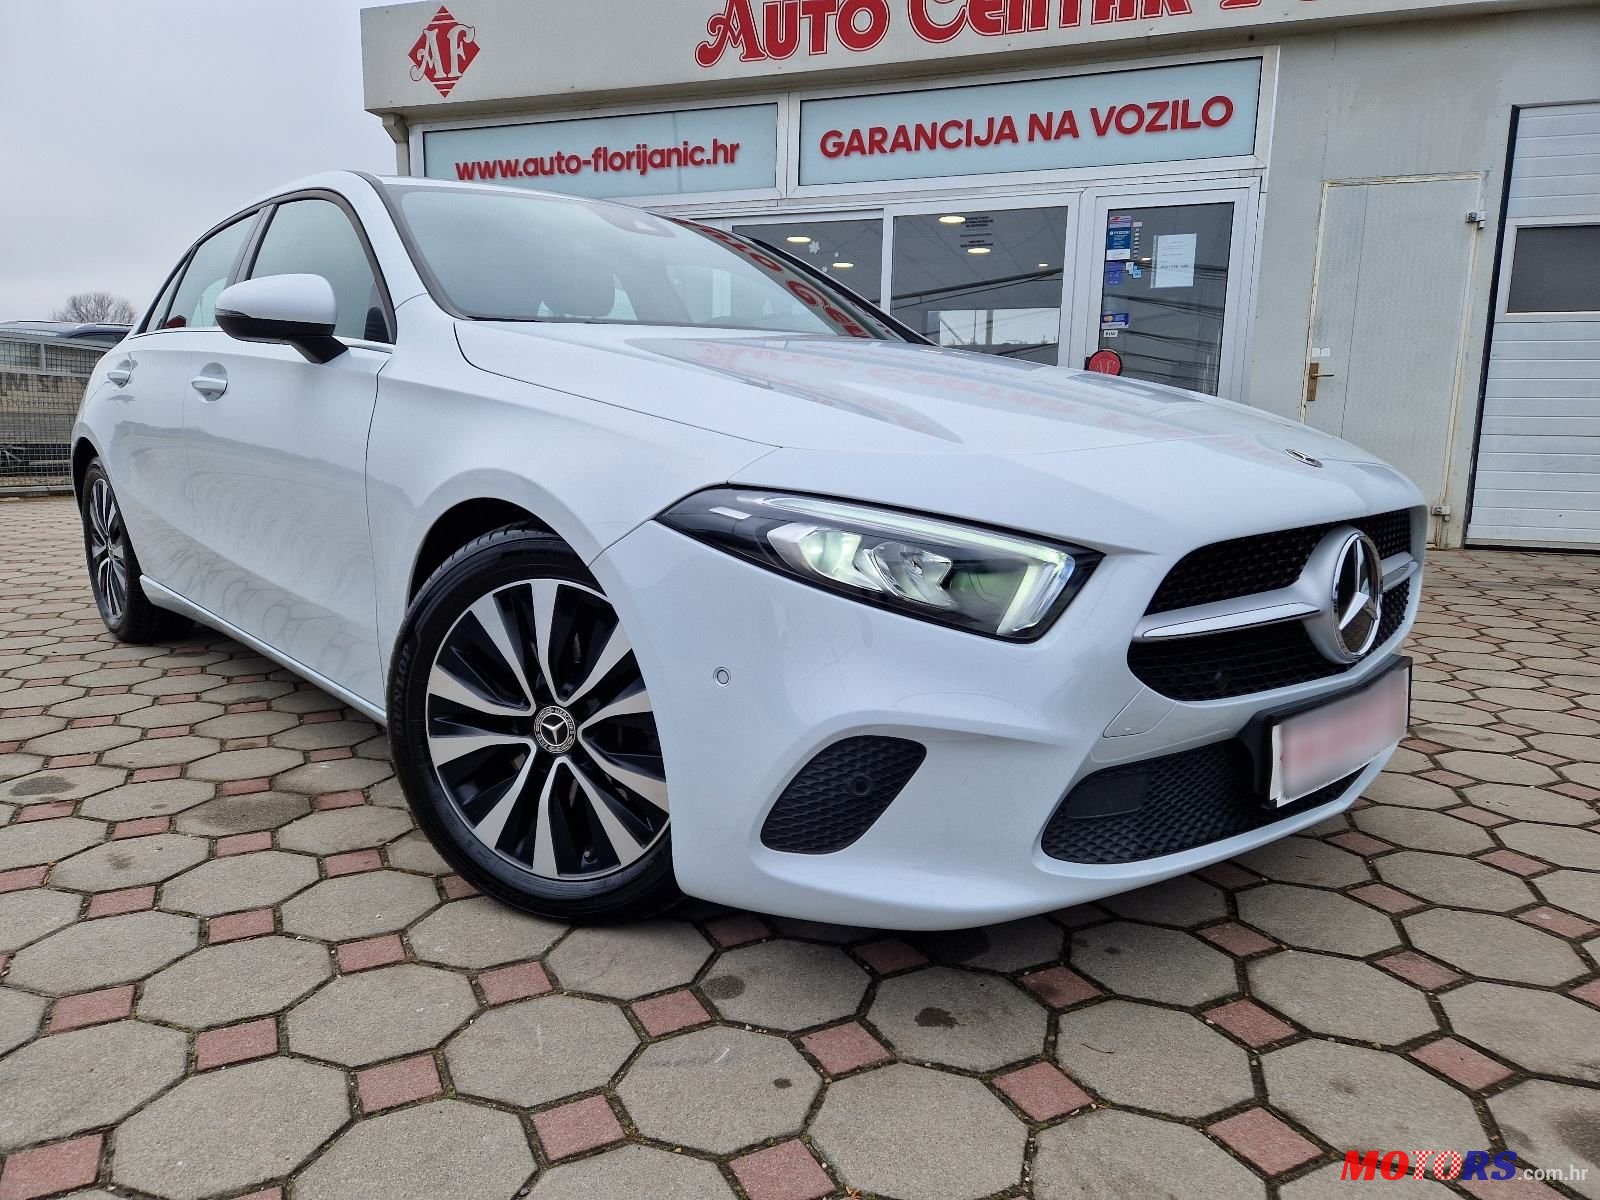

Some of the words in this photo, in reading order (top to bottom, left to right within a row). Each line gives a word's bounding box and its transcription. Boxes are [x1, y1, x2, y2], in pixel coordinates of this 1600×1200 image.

[695, 0, 890, 67] AUTO
[819, 115, 1019, 159] GARANCIJA
[1028, 109, 1080, 142] NA
[1090, 95, 1234, 136] VOZILO
[455, 138, 741, 181] www.auto-florijanic.hr
